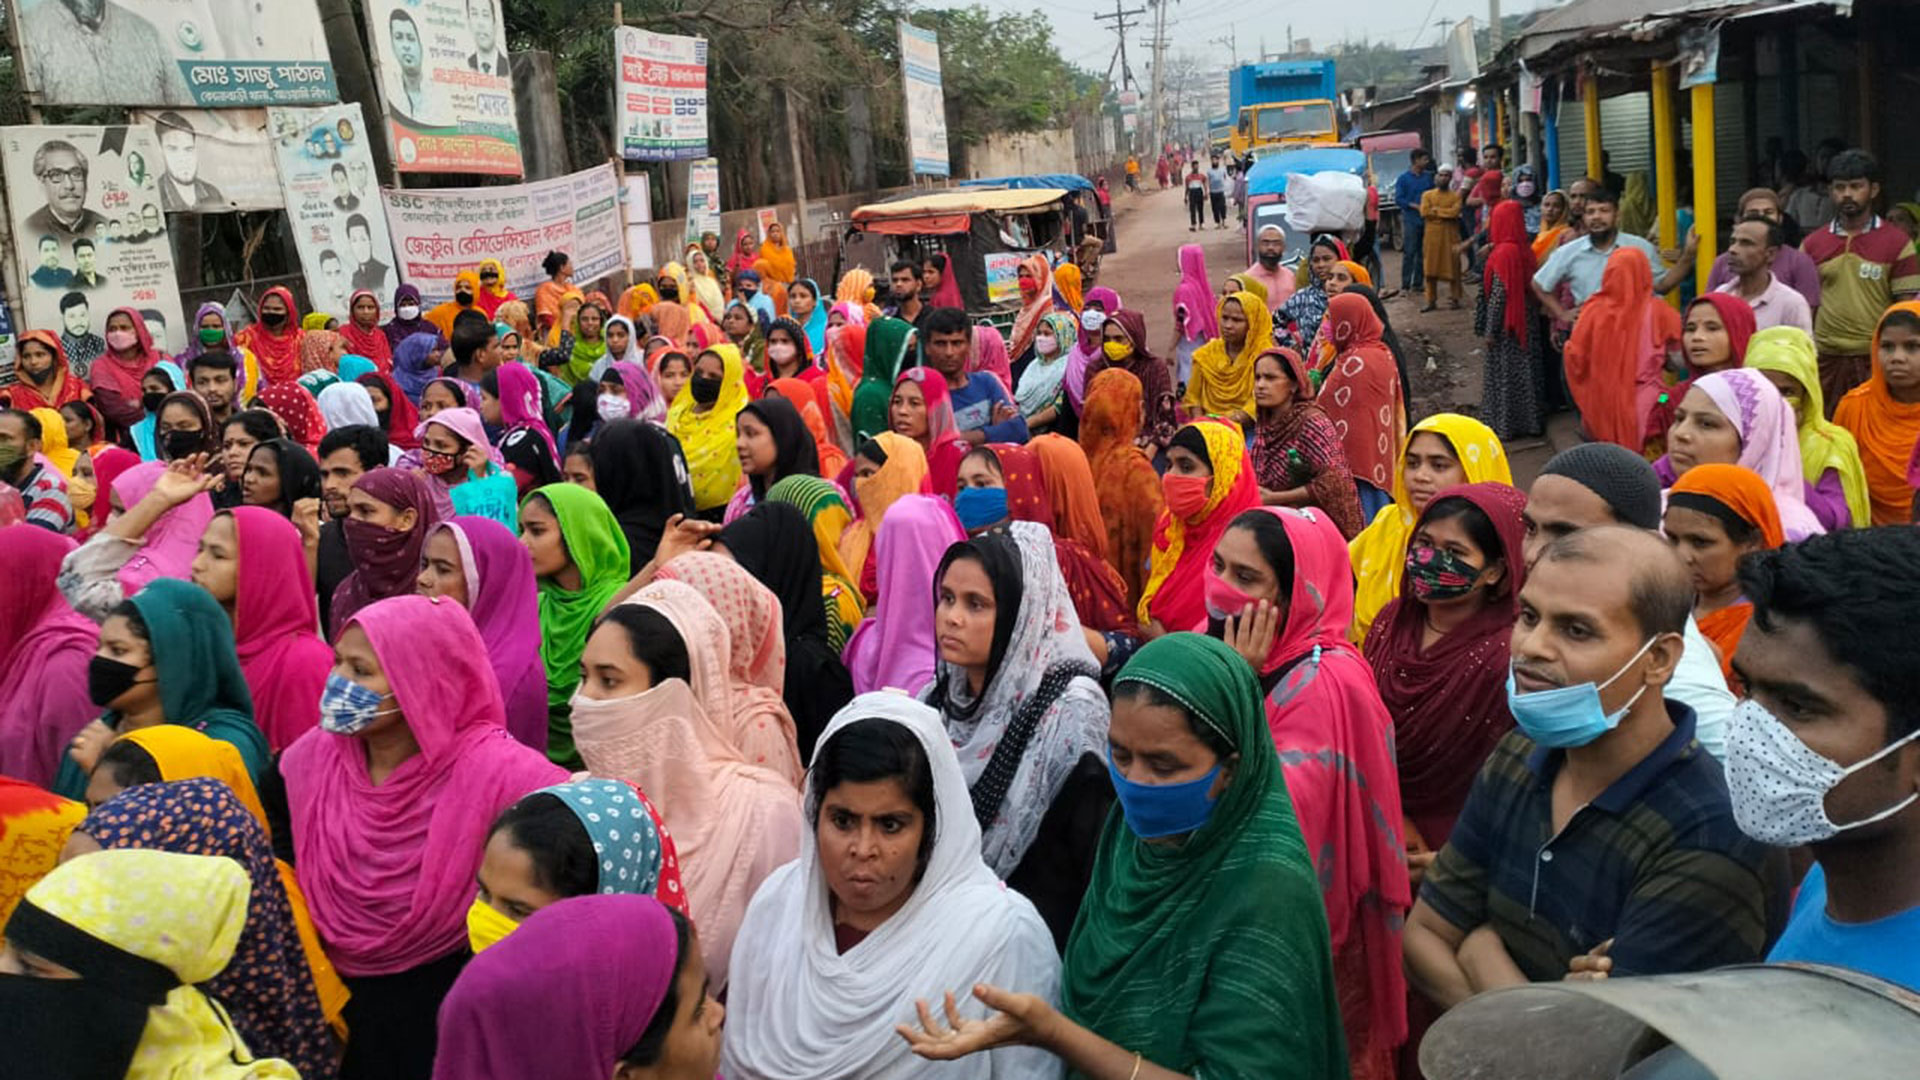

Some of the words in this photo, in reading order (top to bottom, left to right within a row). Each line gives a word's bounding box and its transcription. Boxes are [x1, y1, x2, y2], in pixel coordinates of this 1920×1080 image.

[191, 66, 229, 85] মোঃ
[232, 66, 279, 90] সাজু
[277, 62, 326, 83] পাঠান
[390, 195, 423, 209] SSC
